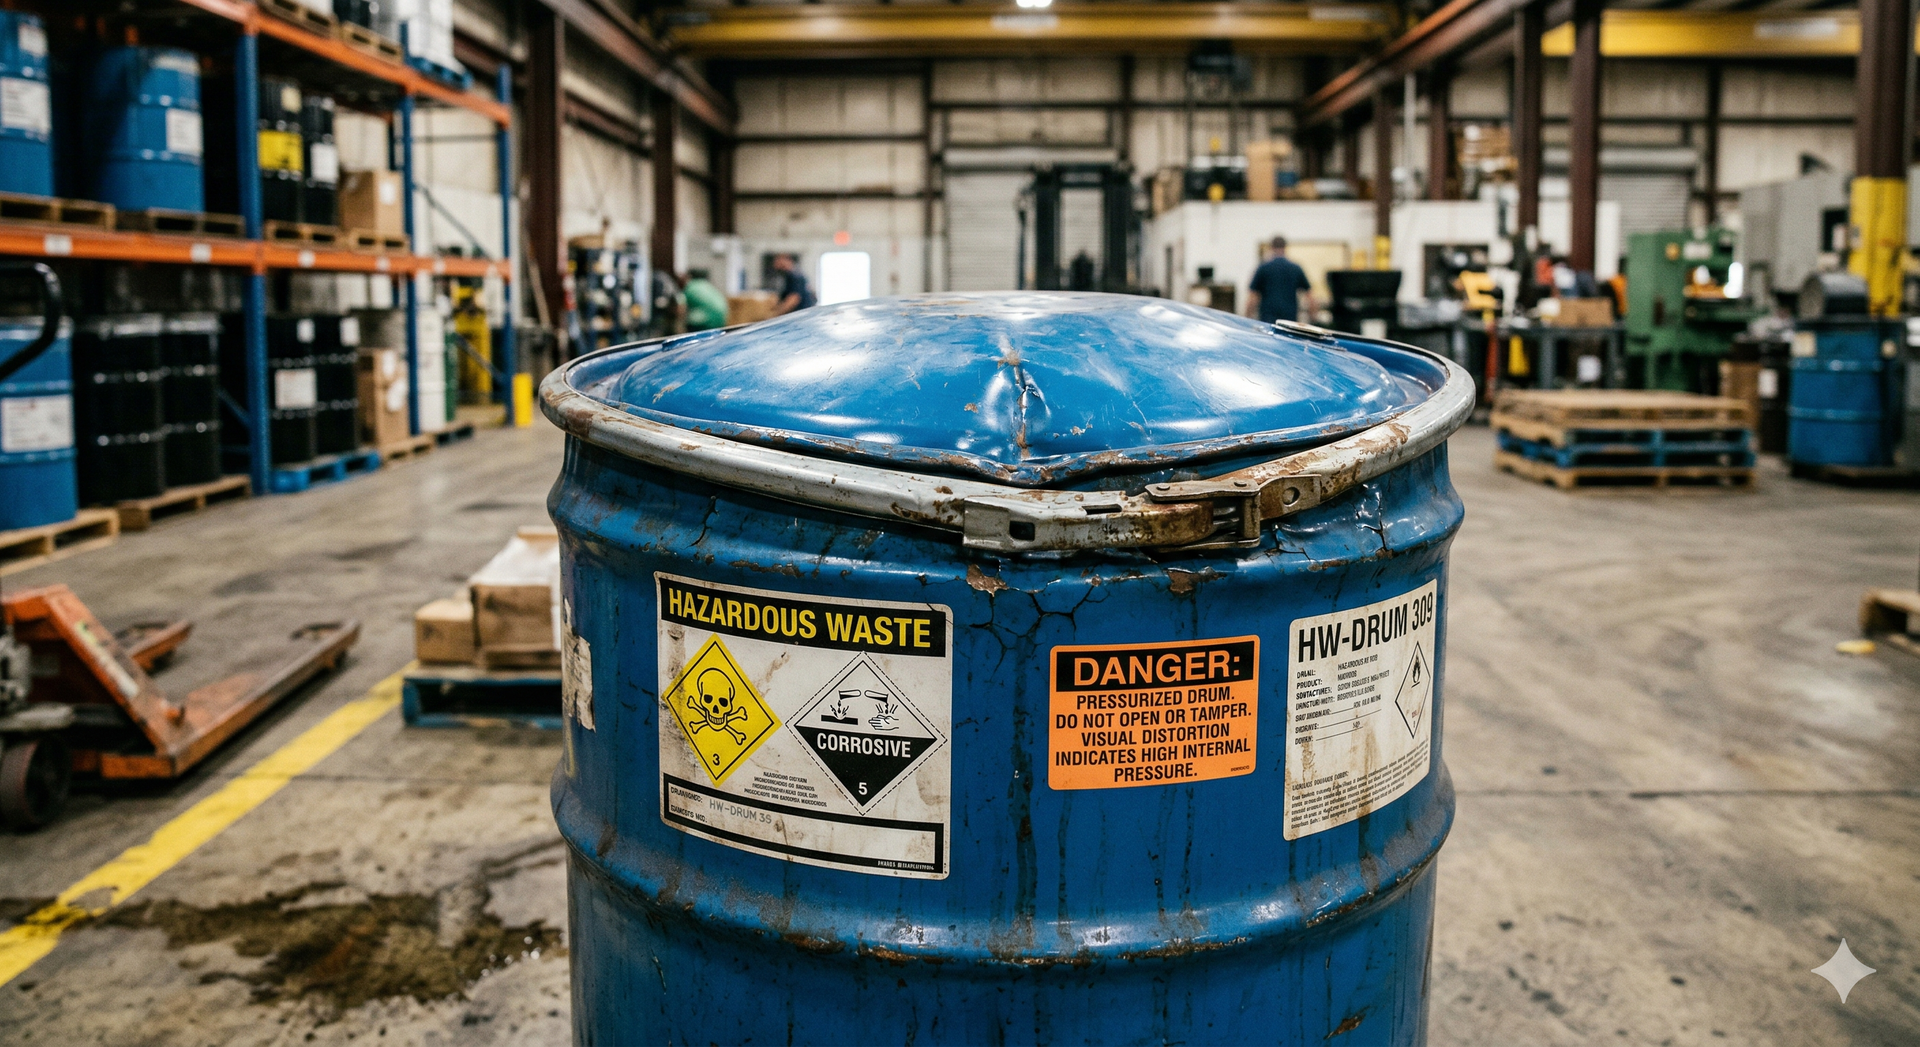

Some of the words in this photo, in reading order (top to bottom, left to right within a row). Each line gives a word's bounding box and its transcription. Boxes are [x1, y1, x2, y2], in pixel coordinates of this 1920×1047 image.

[669, 588, 817, 640] HAZARDOUS
[825, 612, 931, 648] WASTE
[1298, 602, 1408, 663] HW-DRUM
[1412, 591, 1433, 631] 309
[1074, 650, 1240, 686] DANGER:
[1076, 690, 1183, 710] PRESSURIZED
[1187, 686, 1235, 704] DRUM.
[1056, 714, 1078, 729] DO
[1083, 713, 1114, 728] NOT
[1119, 710, 1160, 727] OPEN
[1165, 709, 1185, 725] OR
[1190, 702, 1252, 722] TAMPER.
[816, 732, 911, 758] CORROSIVE
[1081, 730, 1137, 747] VISUAL
[1142, 722, 1230, 744] DISTORTION
[712, 753, 721, 766] 3
[1055, 749, 1136, 766] INDICATES
[1141, 745, 1178, 762] HIGH
[1183, 738, 1251, 759] INTERNAL
[1114, 762, 1198, 783] PRESSURE.
[858, 782, 868, 796] 5
[709, 799, 757, 821] HW-DRUM
